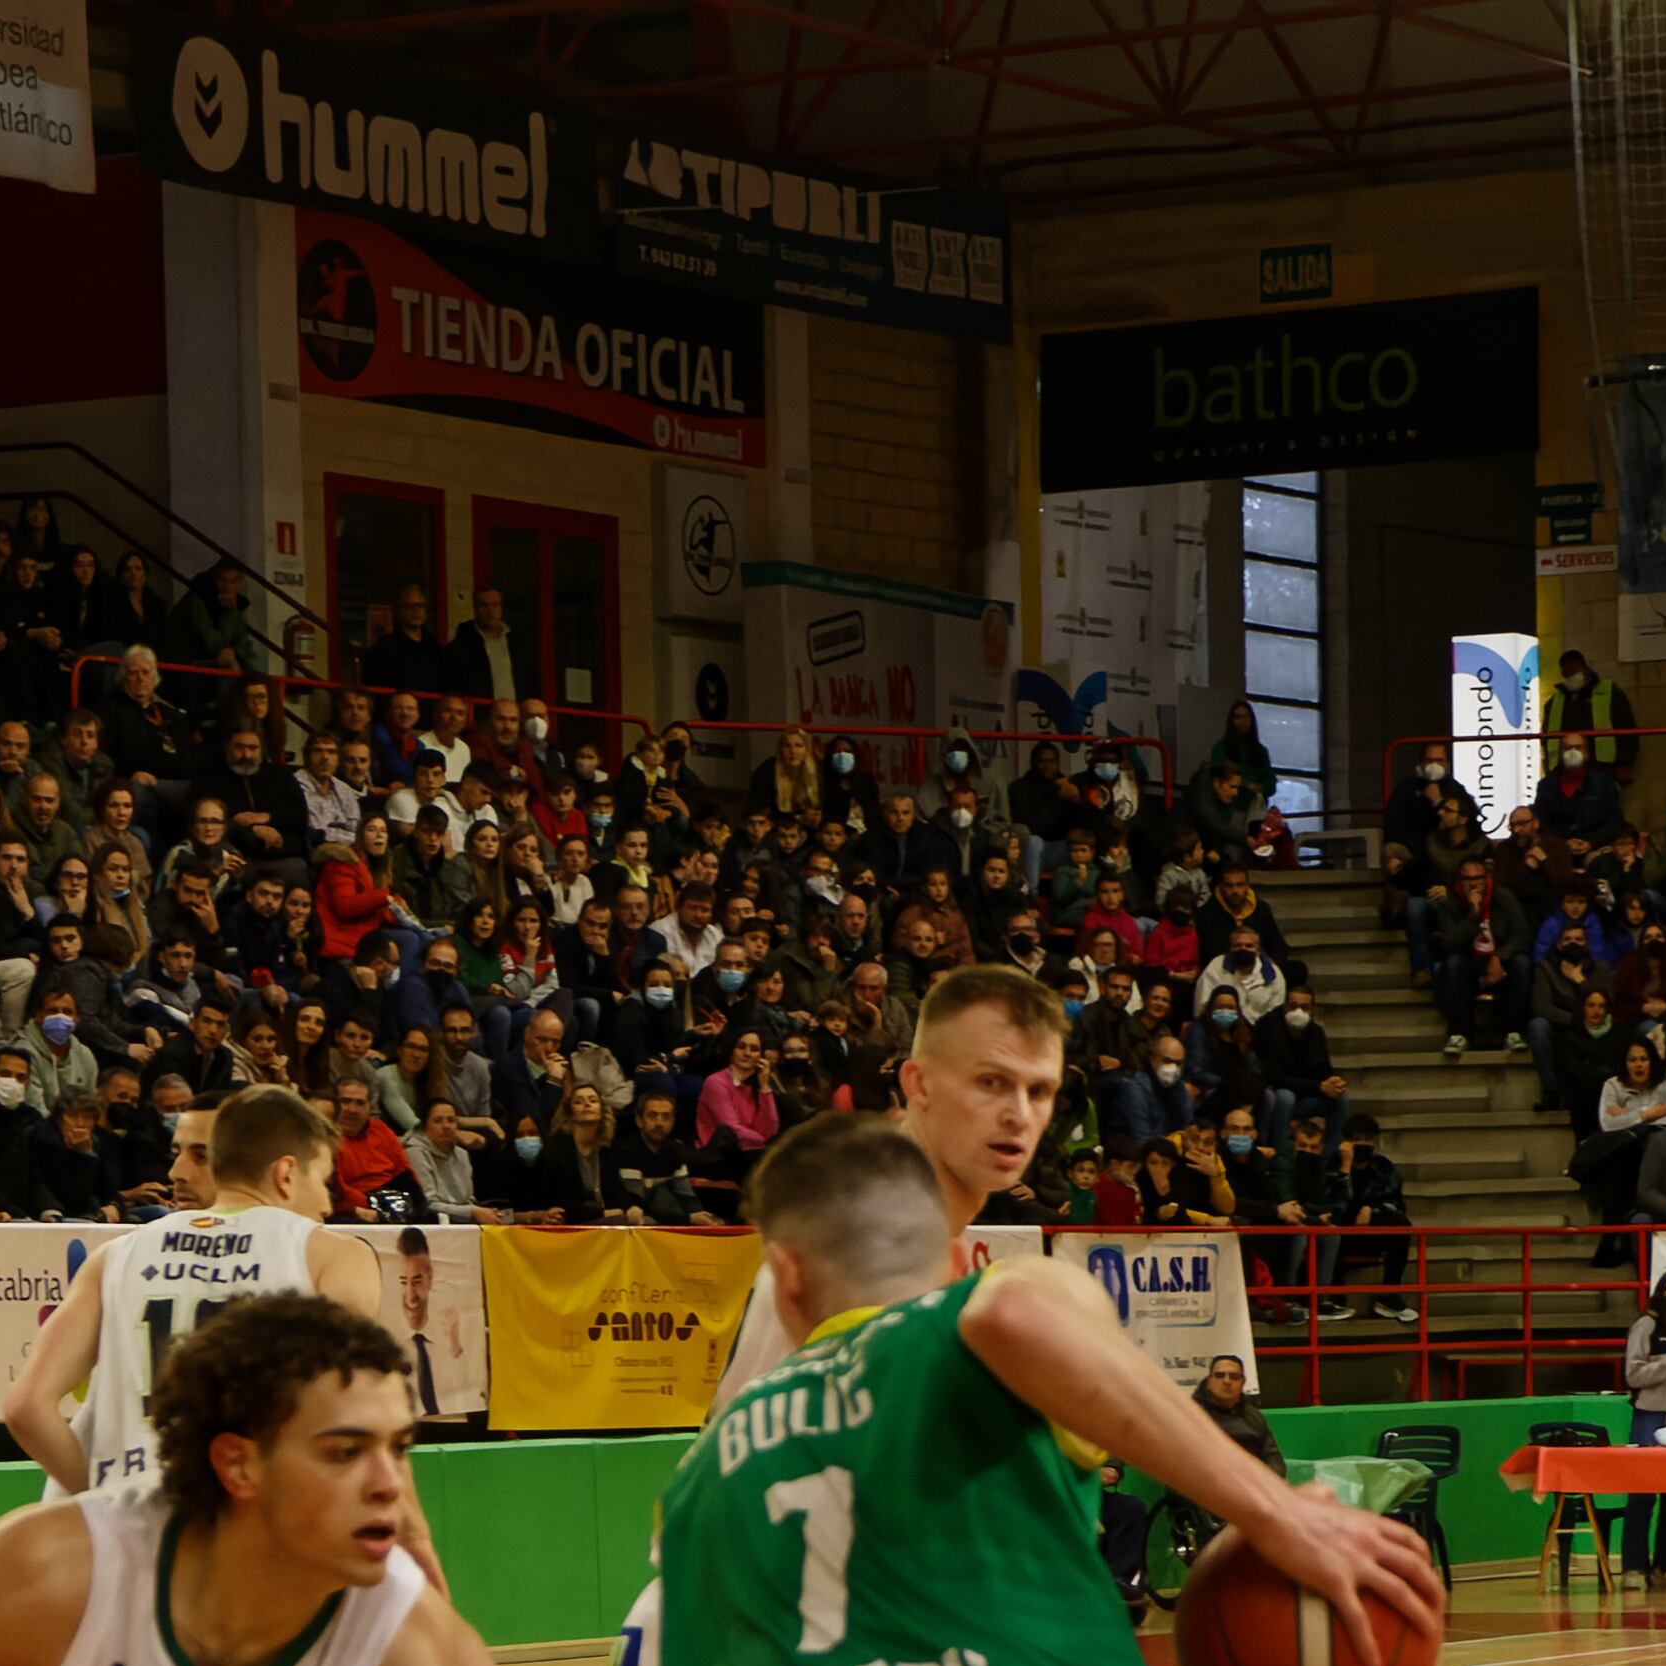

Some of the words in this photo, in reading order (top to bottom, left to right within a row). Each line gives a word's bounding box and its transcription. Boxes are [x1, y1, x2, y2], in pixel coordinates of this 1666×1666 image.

[261, 48, 548, 239] hummel
[1262, 254, 1328, 295] SALIDA
[391, 287, 565, 381] TIENDA
[576, 323, 746, 414] OFICIAL
[1154, 332, 1418, 429] bathco
[161, 1231, 253, 1258] MORENO
[164, 1263, 260, 1284] UCLM
